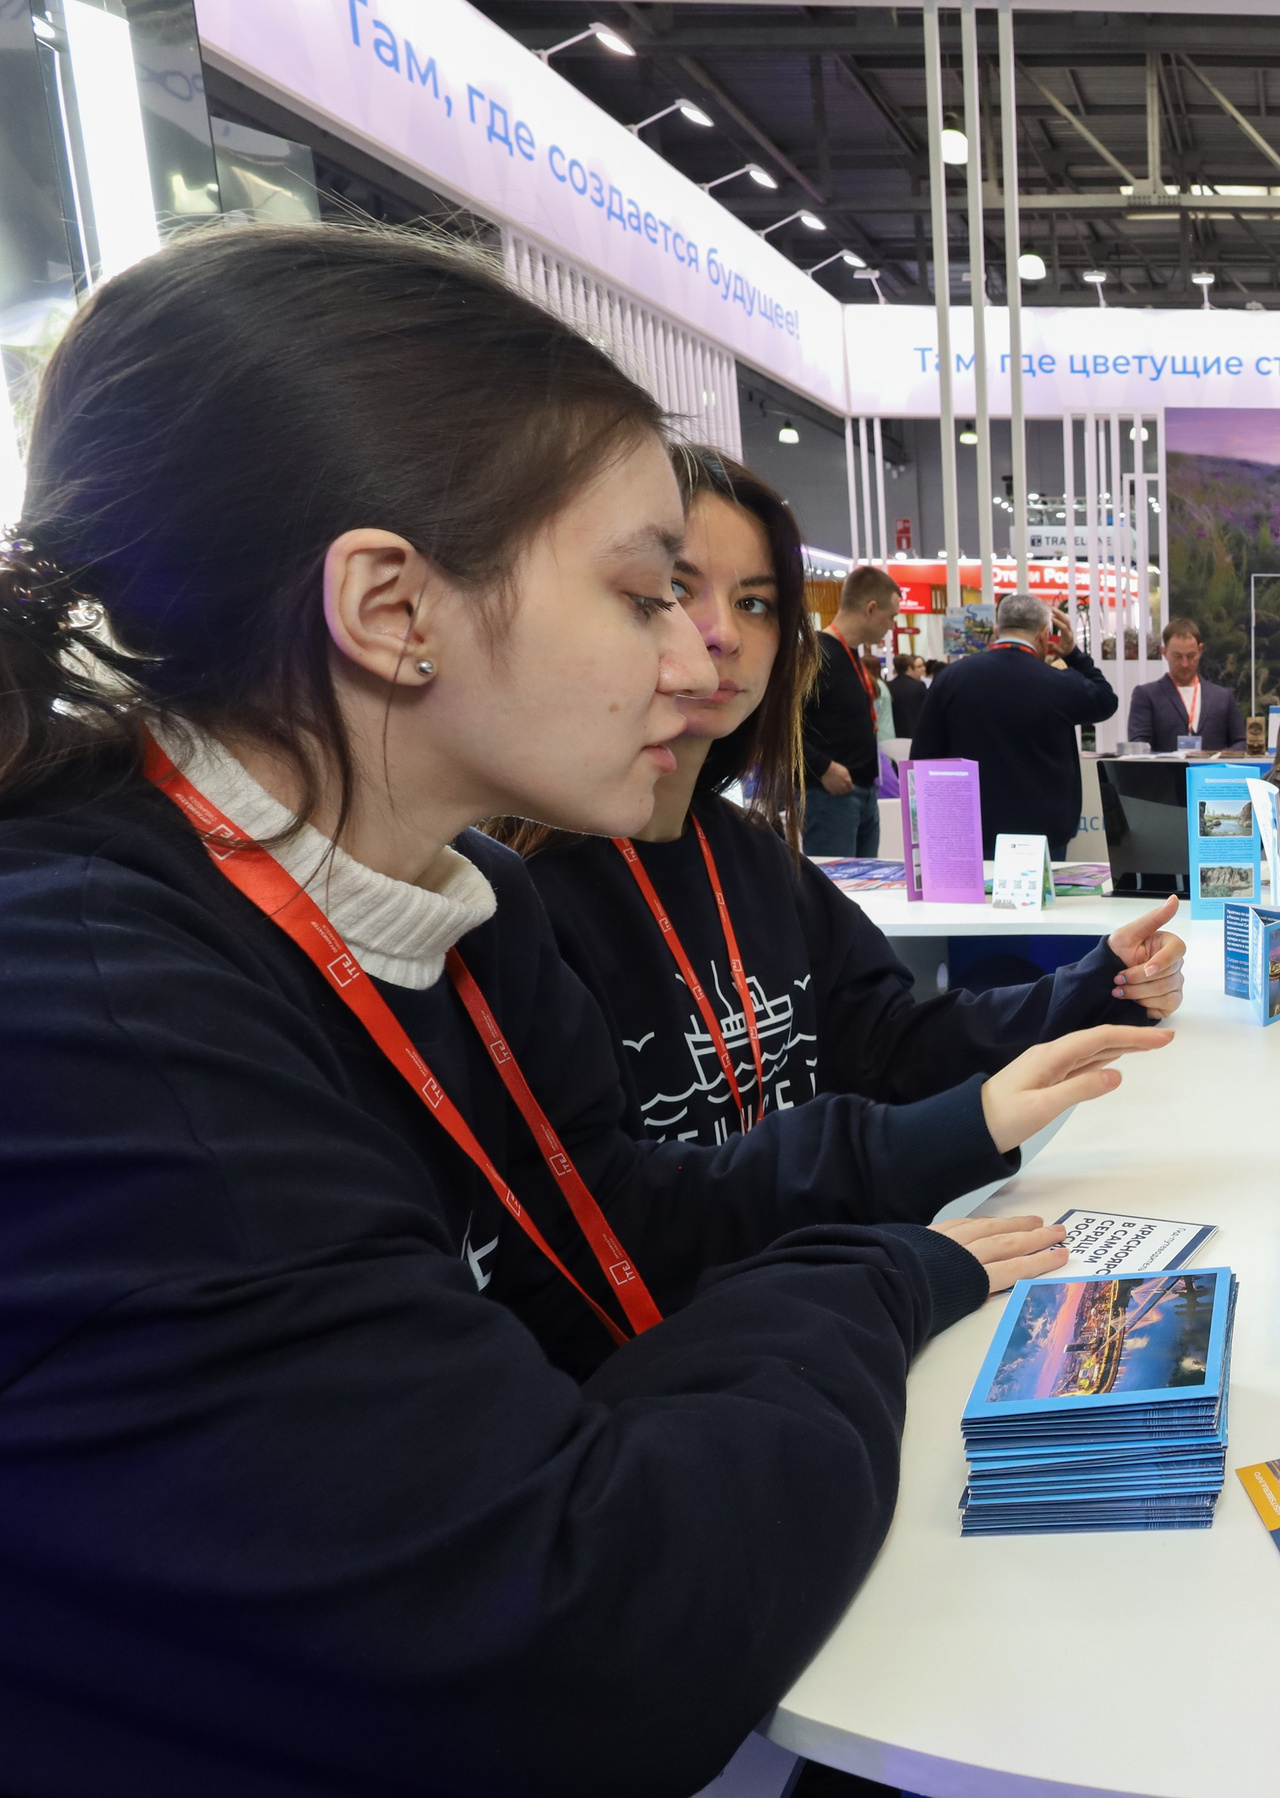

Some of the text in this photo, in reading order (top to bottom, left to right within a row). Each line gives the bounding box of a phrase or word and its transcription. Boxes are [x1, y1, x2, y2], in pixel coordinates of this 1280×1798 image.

[466, 83, 536, 162] где
[548, 144, 700, 273] создается
[706, 247, 801, 340] будущее!
[1069, 353, 1243, 381] цветущие
[1070, 1219, 1116, 1255] СЕРДЦЕ
[1083, 1229, 1128, 1264] САМОМ
[1094, 1223, 1158, 1277] КРАСНОЯРС
